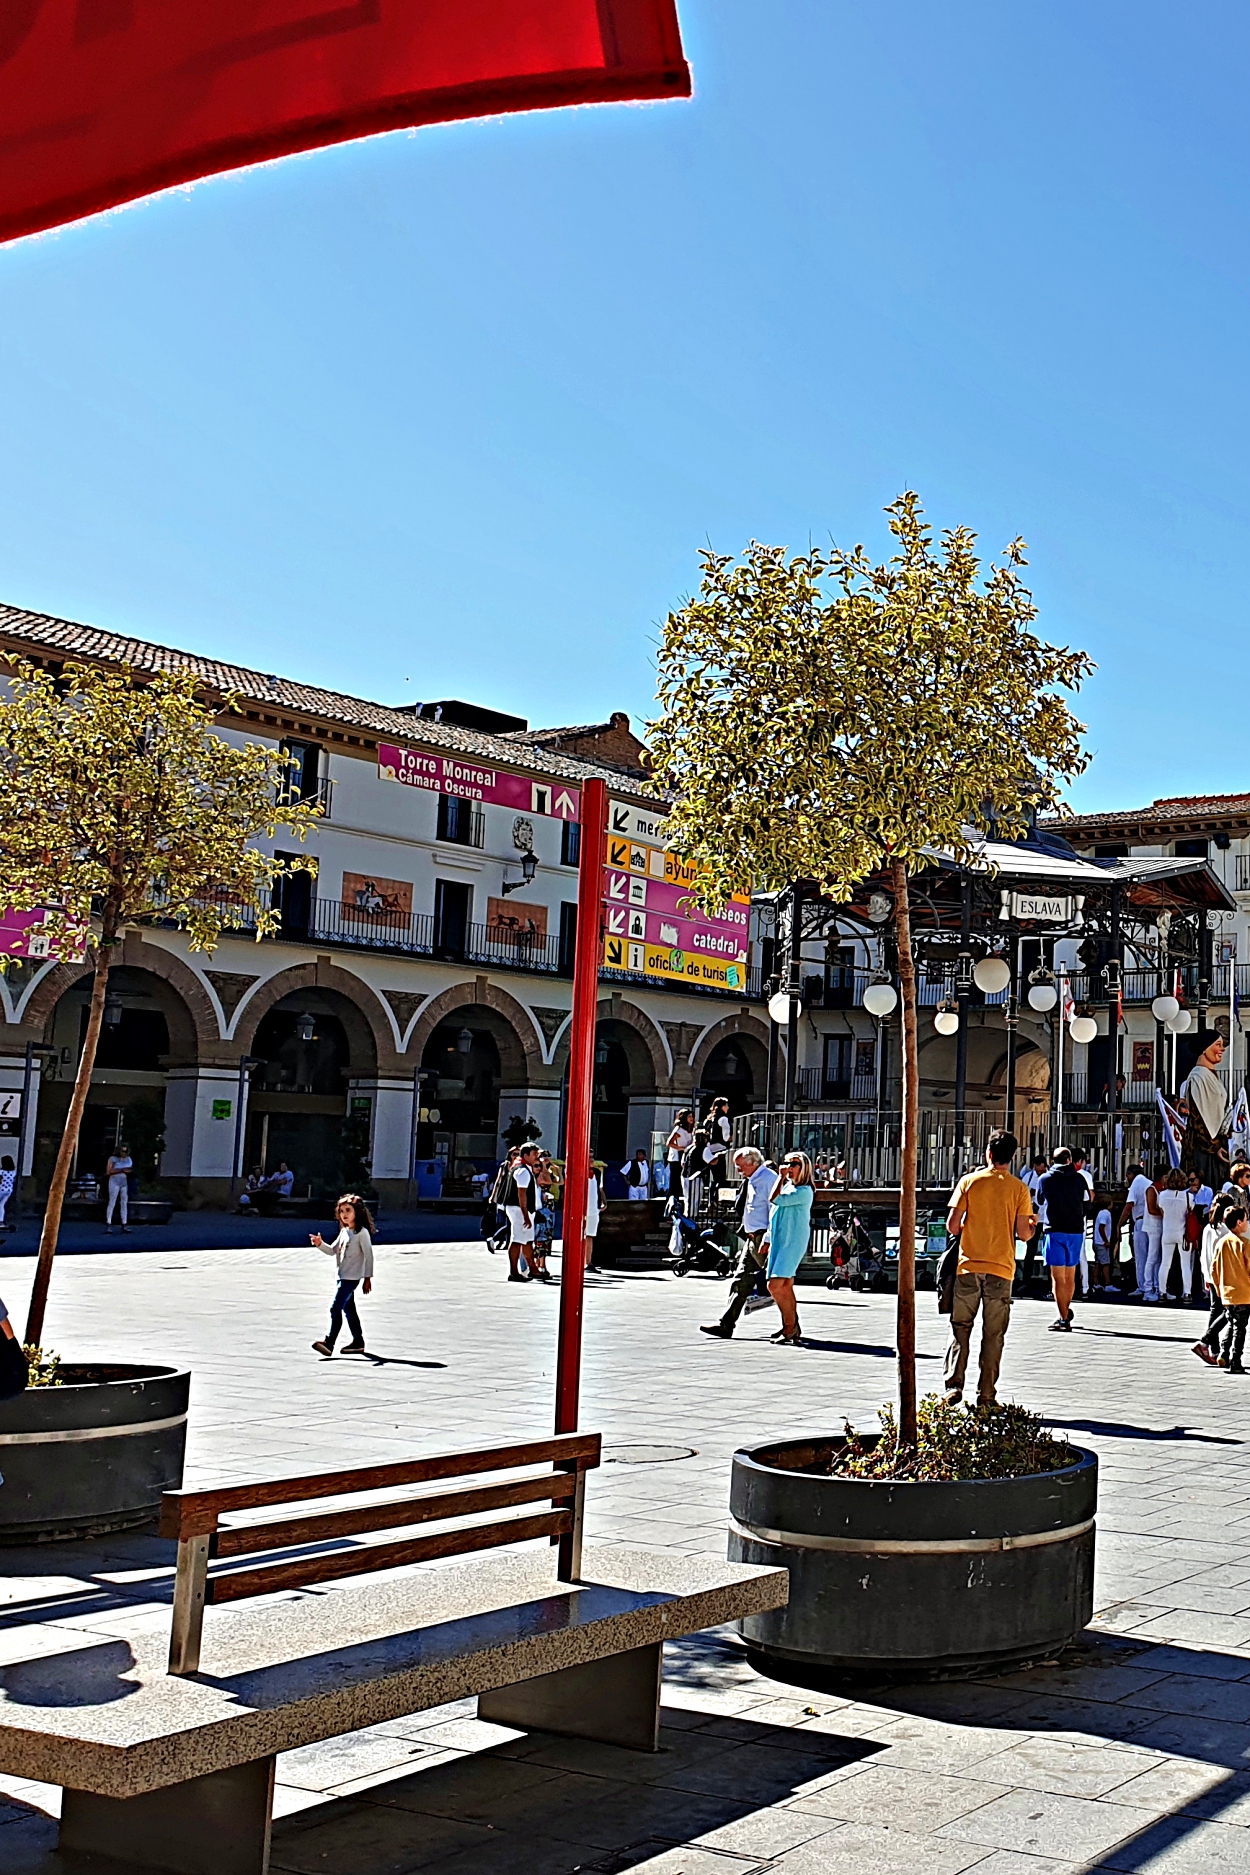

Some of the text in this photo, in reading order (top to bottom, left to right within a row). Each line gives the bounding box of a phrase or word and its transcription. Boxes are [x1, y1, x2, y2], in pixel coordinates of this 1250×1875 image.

[399, 749, 496, 788] Torre Monreal
[398, 768, 483, 800] Cámara Oscura
[697, 904, 747, 925] useos
[1020, 900, 1062, 916] ESLAVA
[693, 932, 738, 955] catedral
[686, 961, 700, 977] de
